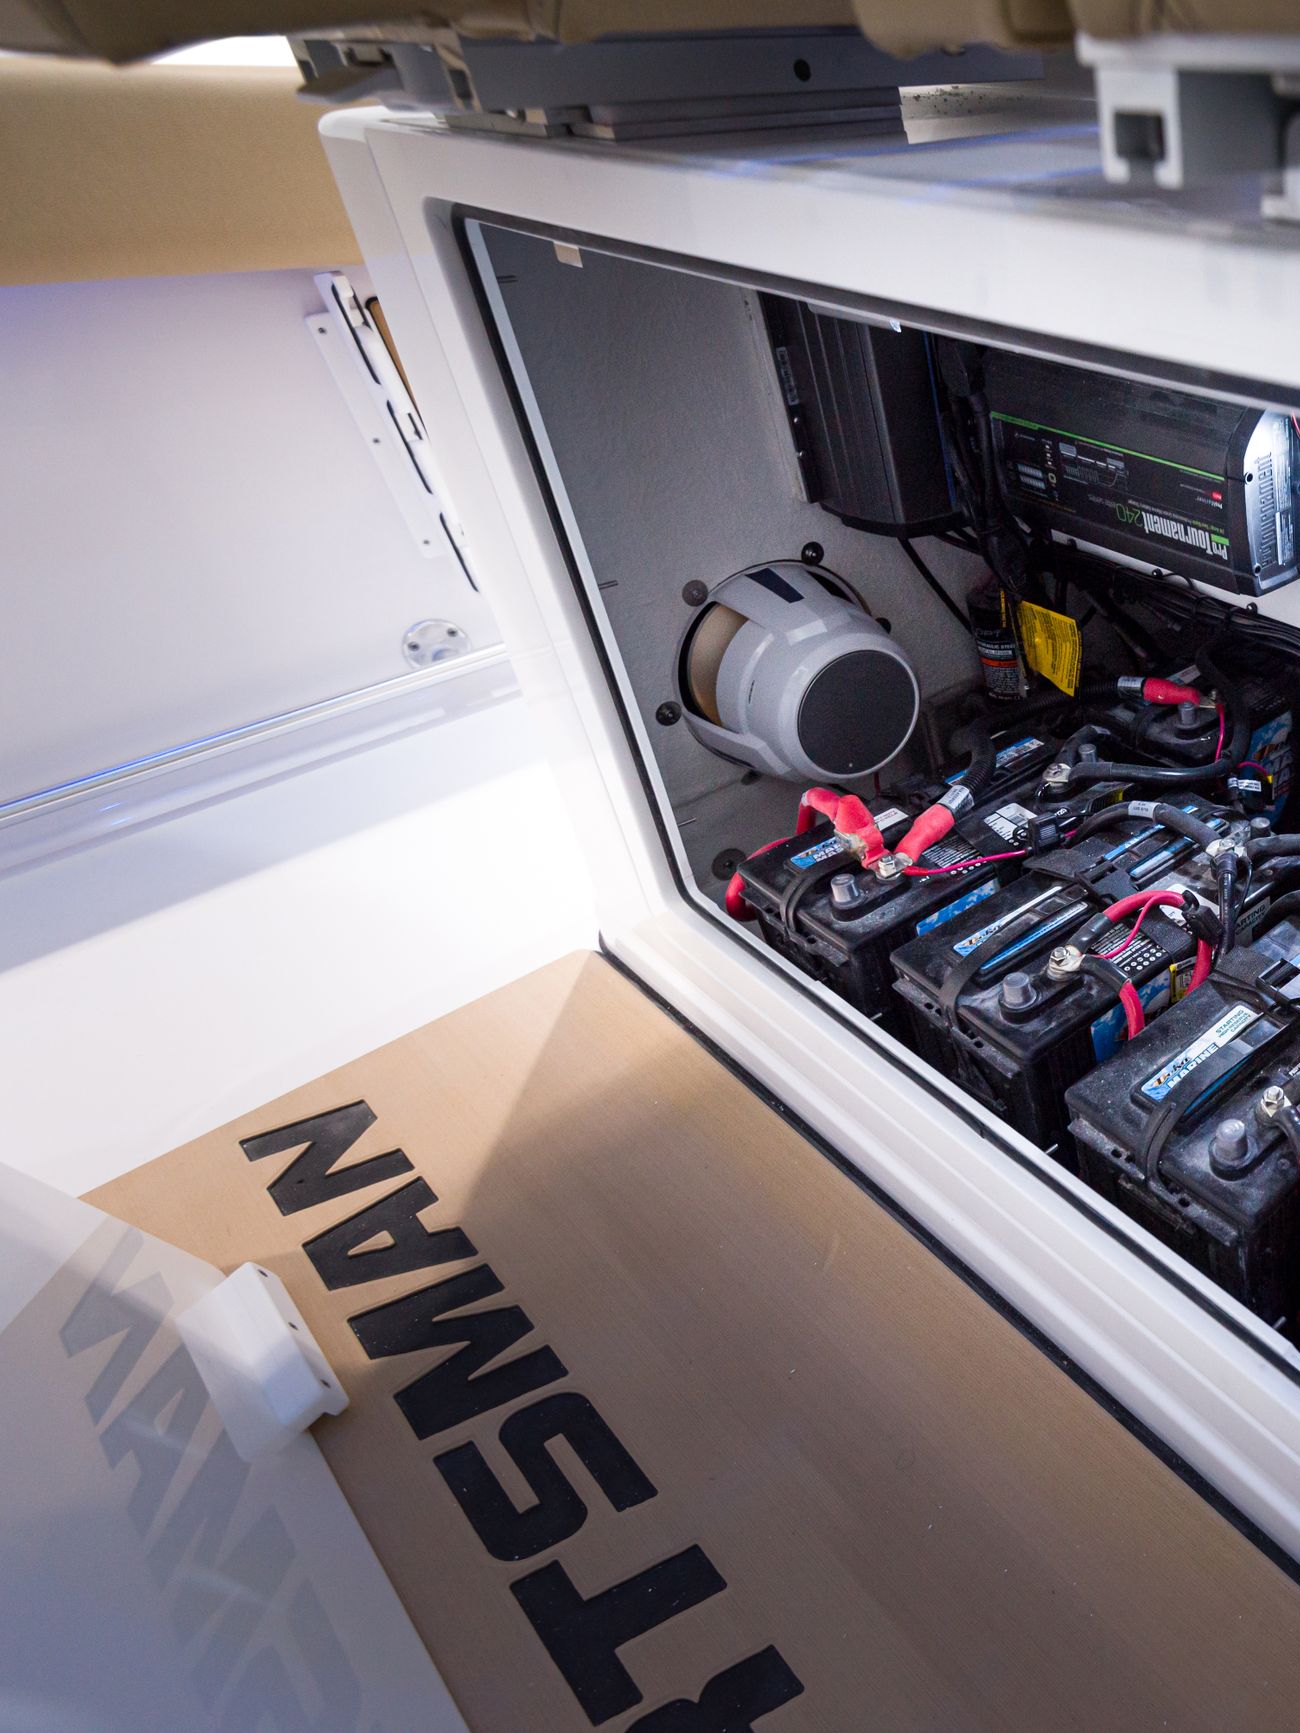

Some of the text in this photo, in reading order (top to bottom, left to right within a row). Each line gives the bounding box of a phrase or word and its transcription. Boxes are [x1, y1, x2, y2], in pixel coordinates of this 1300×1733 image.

[1116, 502, 1141, 526] 240
[1215, 1009, 1244, 1034] STARTING
[1165, 1041, 1219, 1088] MARINE
